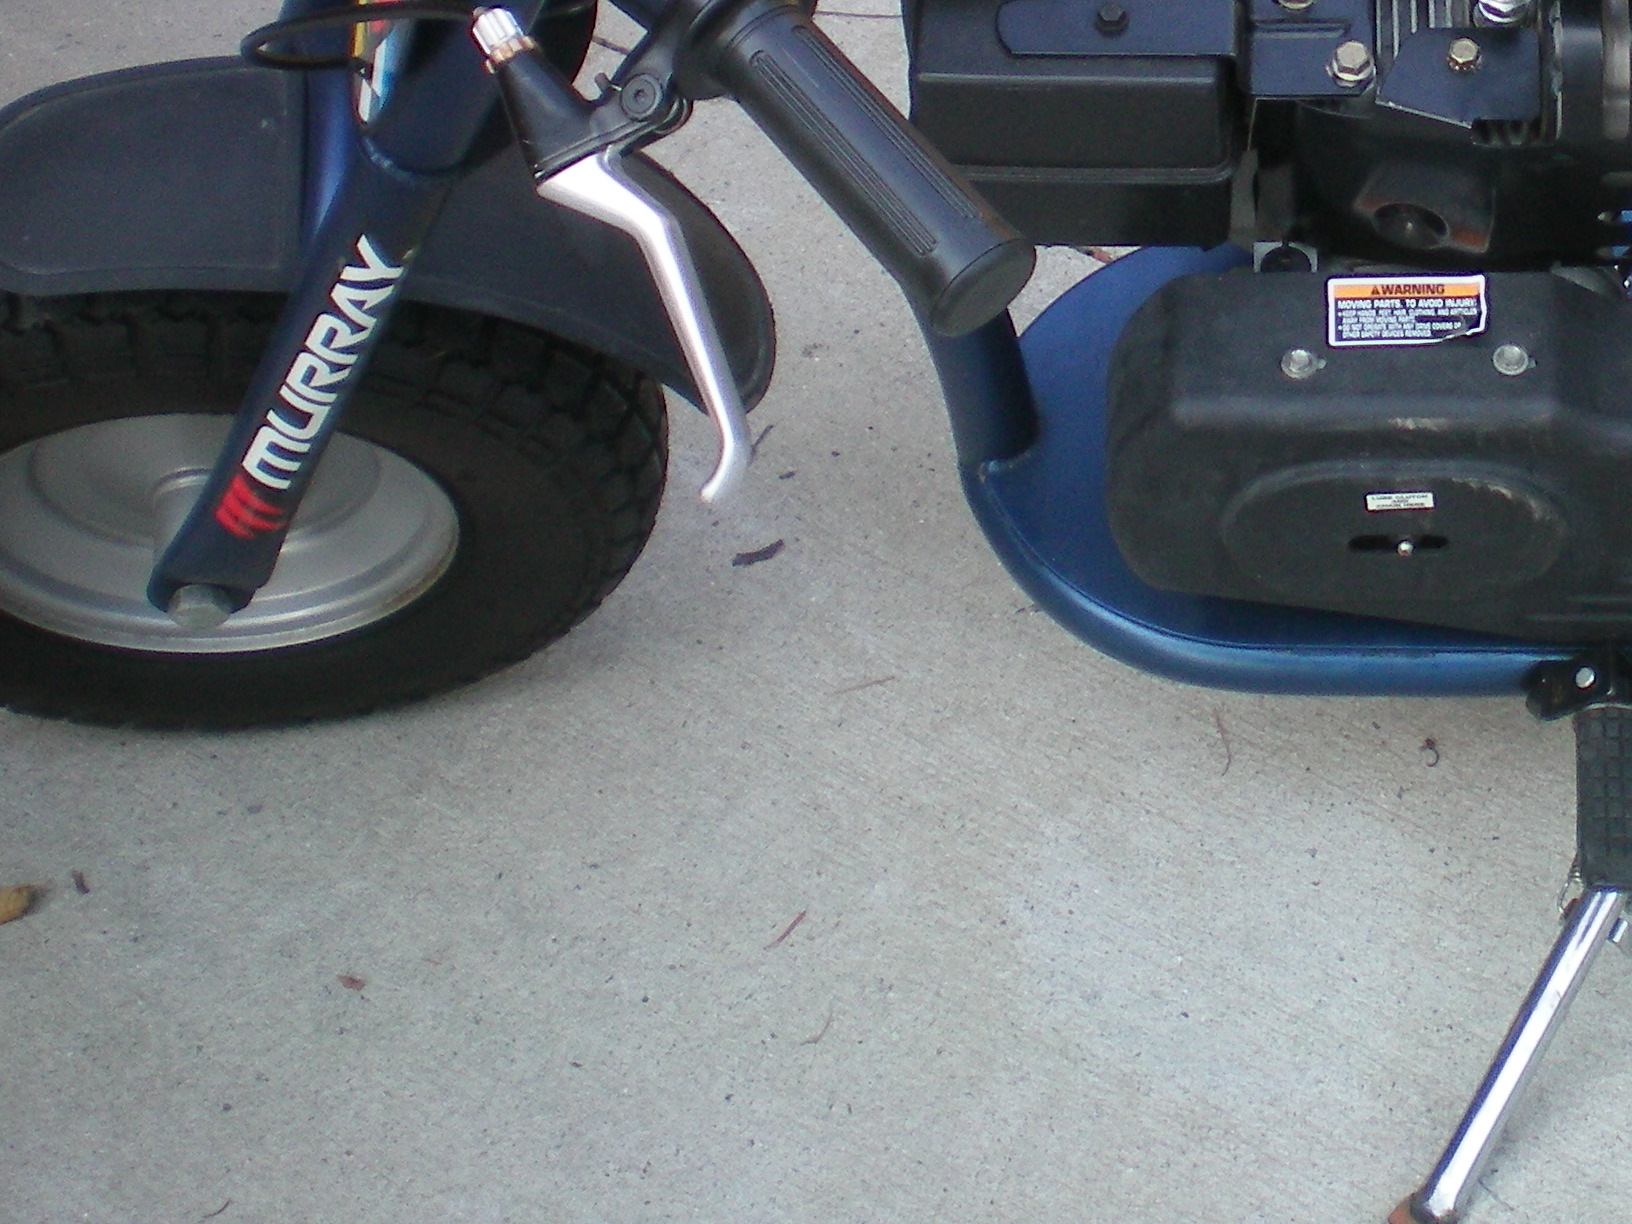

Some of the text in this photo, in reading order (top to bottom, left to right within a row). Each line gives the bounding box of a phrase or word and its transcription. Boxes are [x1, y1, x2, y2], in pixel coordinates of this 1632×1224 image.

[1382, 284, 1446, 296] WARNING
[1338, 299, 1372, 309] MOVING
[1405, 299, 1417, 308] TO
[1418, 298, 1443, 308] AVOID
[241, 233, 405, 491] MURRAY
